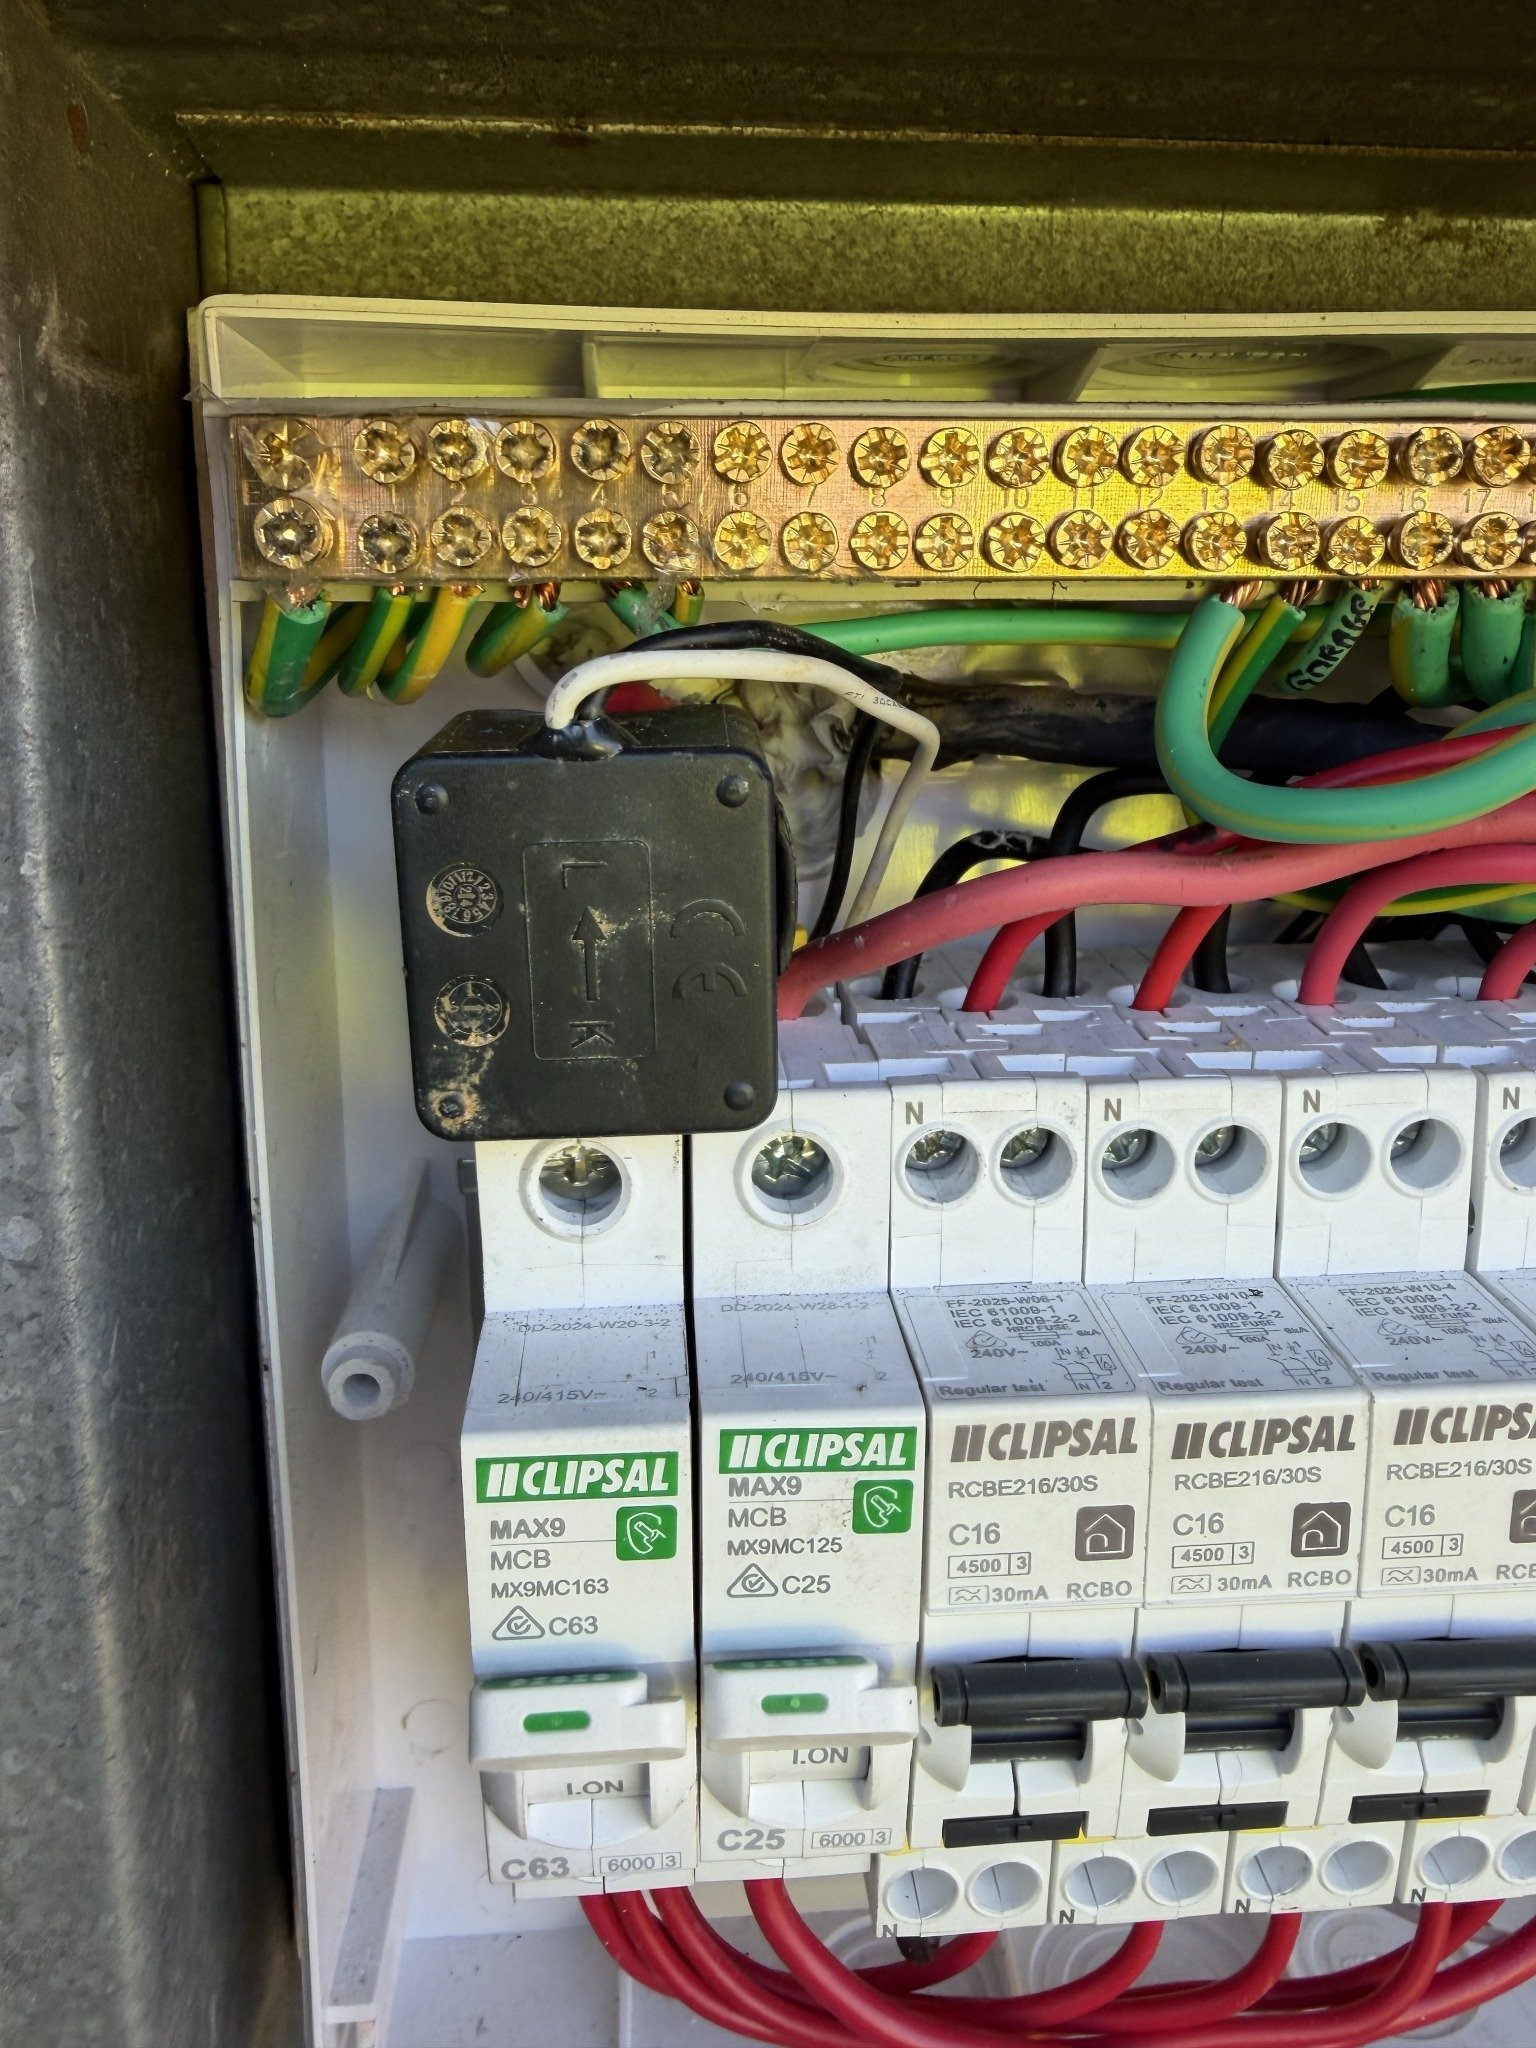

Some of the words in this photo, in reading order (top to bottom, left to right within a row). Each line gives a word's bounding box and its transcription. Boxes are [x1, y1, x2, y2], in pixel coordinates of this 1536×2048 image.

[450, 481, 467, 506] 2
[521, 482, 538, 506] 3
[590, 482, 608, 505] 4
[732, 483, 749, 507] 6
[871, 484, 887, 508] 8
[938, 486, 956, 508] 9
[1002, 487, 1031, 510] 10
[1069, 486, 1096, 511] 11
[1135, 486, 1164, 510] 12
[1201, 486, 1231, 511] 13
[1266, 488, 1297, 512] 14
[1334, 488, 1362, 512] 15
[1397, 487, 1428, 513] 16
[1462, 488, 1493, 514] 17
[1302, 1089, 1321, 1113] N
[1502, 1086, 1520, 1110] N
[904, 1102, 924, 1126] N
[1103, 1098, 1122, 1122] N
[1152, 1305, 1185, 1315] IEC
[1347, 1297, 1381, 1307] IEC
[1355, 1307, 1388, 1317] IEC
[950, 1309, 983, 1318] IEC
[954, 1319, 987, 1328] IEC
[1158, 1315, 1192, 1325] IEC
[1037, 1323, 1072, 1331] FUSE
[988, 1417, 1138, 1462] CLIPSAL
[1208, 1414, 1357, 1458] CLIPSAL
[764, 1432, 907, 1468] CLIPSAL
[522, 1457, 669, 1496] CLIPSAL
[1174, 1466, 1322, 1491] RCBE216/30S
[1386, 1458, 1533, 1481] RCBE216/30S
[728, 1475, 803, 1497] MAX9
[948, 1475, 1099, 1499] RCBE216/30S
[728, 1506, 787, 1528] MCB
[1172, 1512, 1224, 1536] C16
[1384, 1504, 1436, 1528] C16
[490, 1517, 566, 1540] MAX9
[949, 1522, 1001, 1546] C16
[727, 1536, 843, 1556] MX9MC125
[1180, 1547, 1224, 1563] 4500
[1238, 1545, 1250, 1560] 3
[1390, 1540, 1434, 1555] 4500
[1449, 1537, 1459, 1552] 3
[490, 1549, 552, 1571] MCB
[956, 1558, 1002, 1574] 4500
[1016, 1555, 1028, 1571] 3
[781, 1575, 831, 1595] C25
[1217, 1574, 1272, 1592] 30mA
[1287, 1569, 1352, 1588] RCBO
[1423, 1566, 1479, 1584] 30mA
[491, 1578, 610, 1599] MX9MC163
[992, 1585, 1049, 1602] 30mA
[1066, 1580, 1133, 1599] RCBO
[548, 1615, 599, 1637] C63
[717, 1828, 786, 1851] C25
[819, 1832, 866, 1847] 6000
[874, 1831, 888, 1845] 3
[501, 1857, 570, 1881] C63
[607, 1855, 655, 1871] 6000
[664, 1855, 677, 1869] 3
[1234, 1899, 1252, 1914] N
[1410, 1887, 1427, 1904] N
[1059, 1908, 1076, 1924] N
[883, 1923, 899, 1938] N
